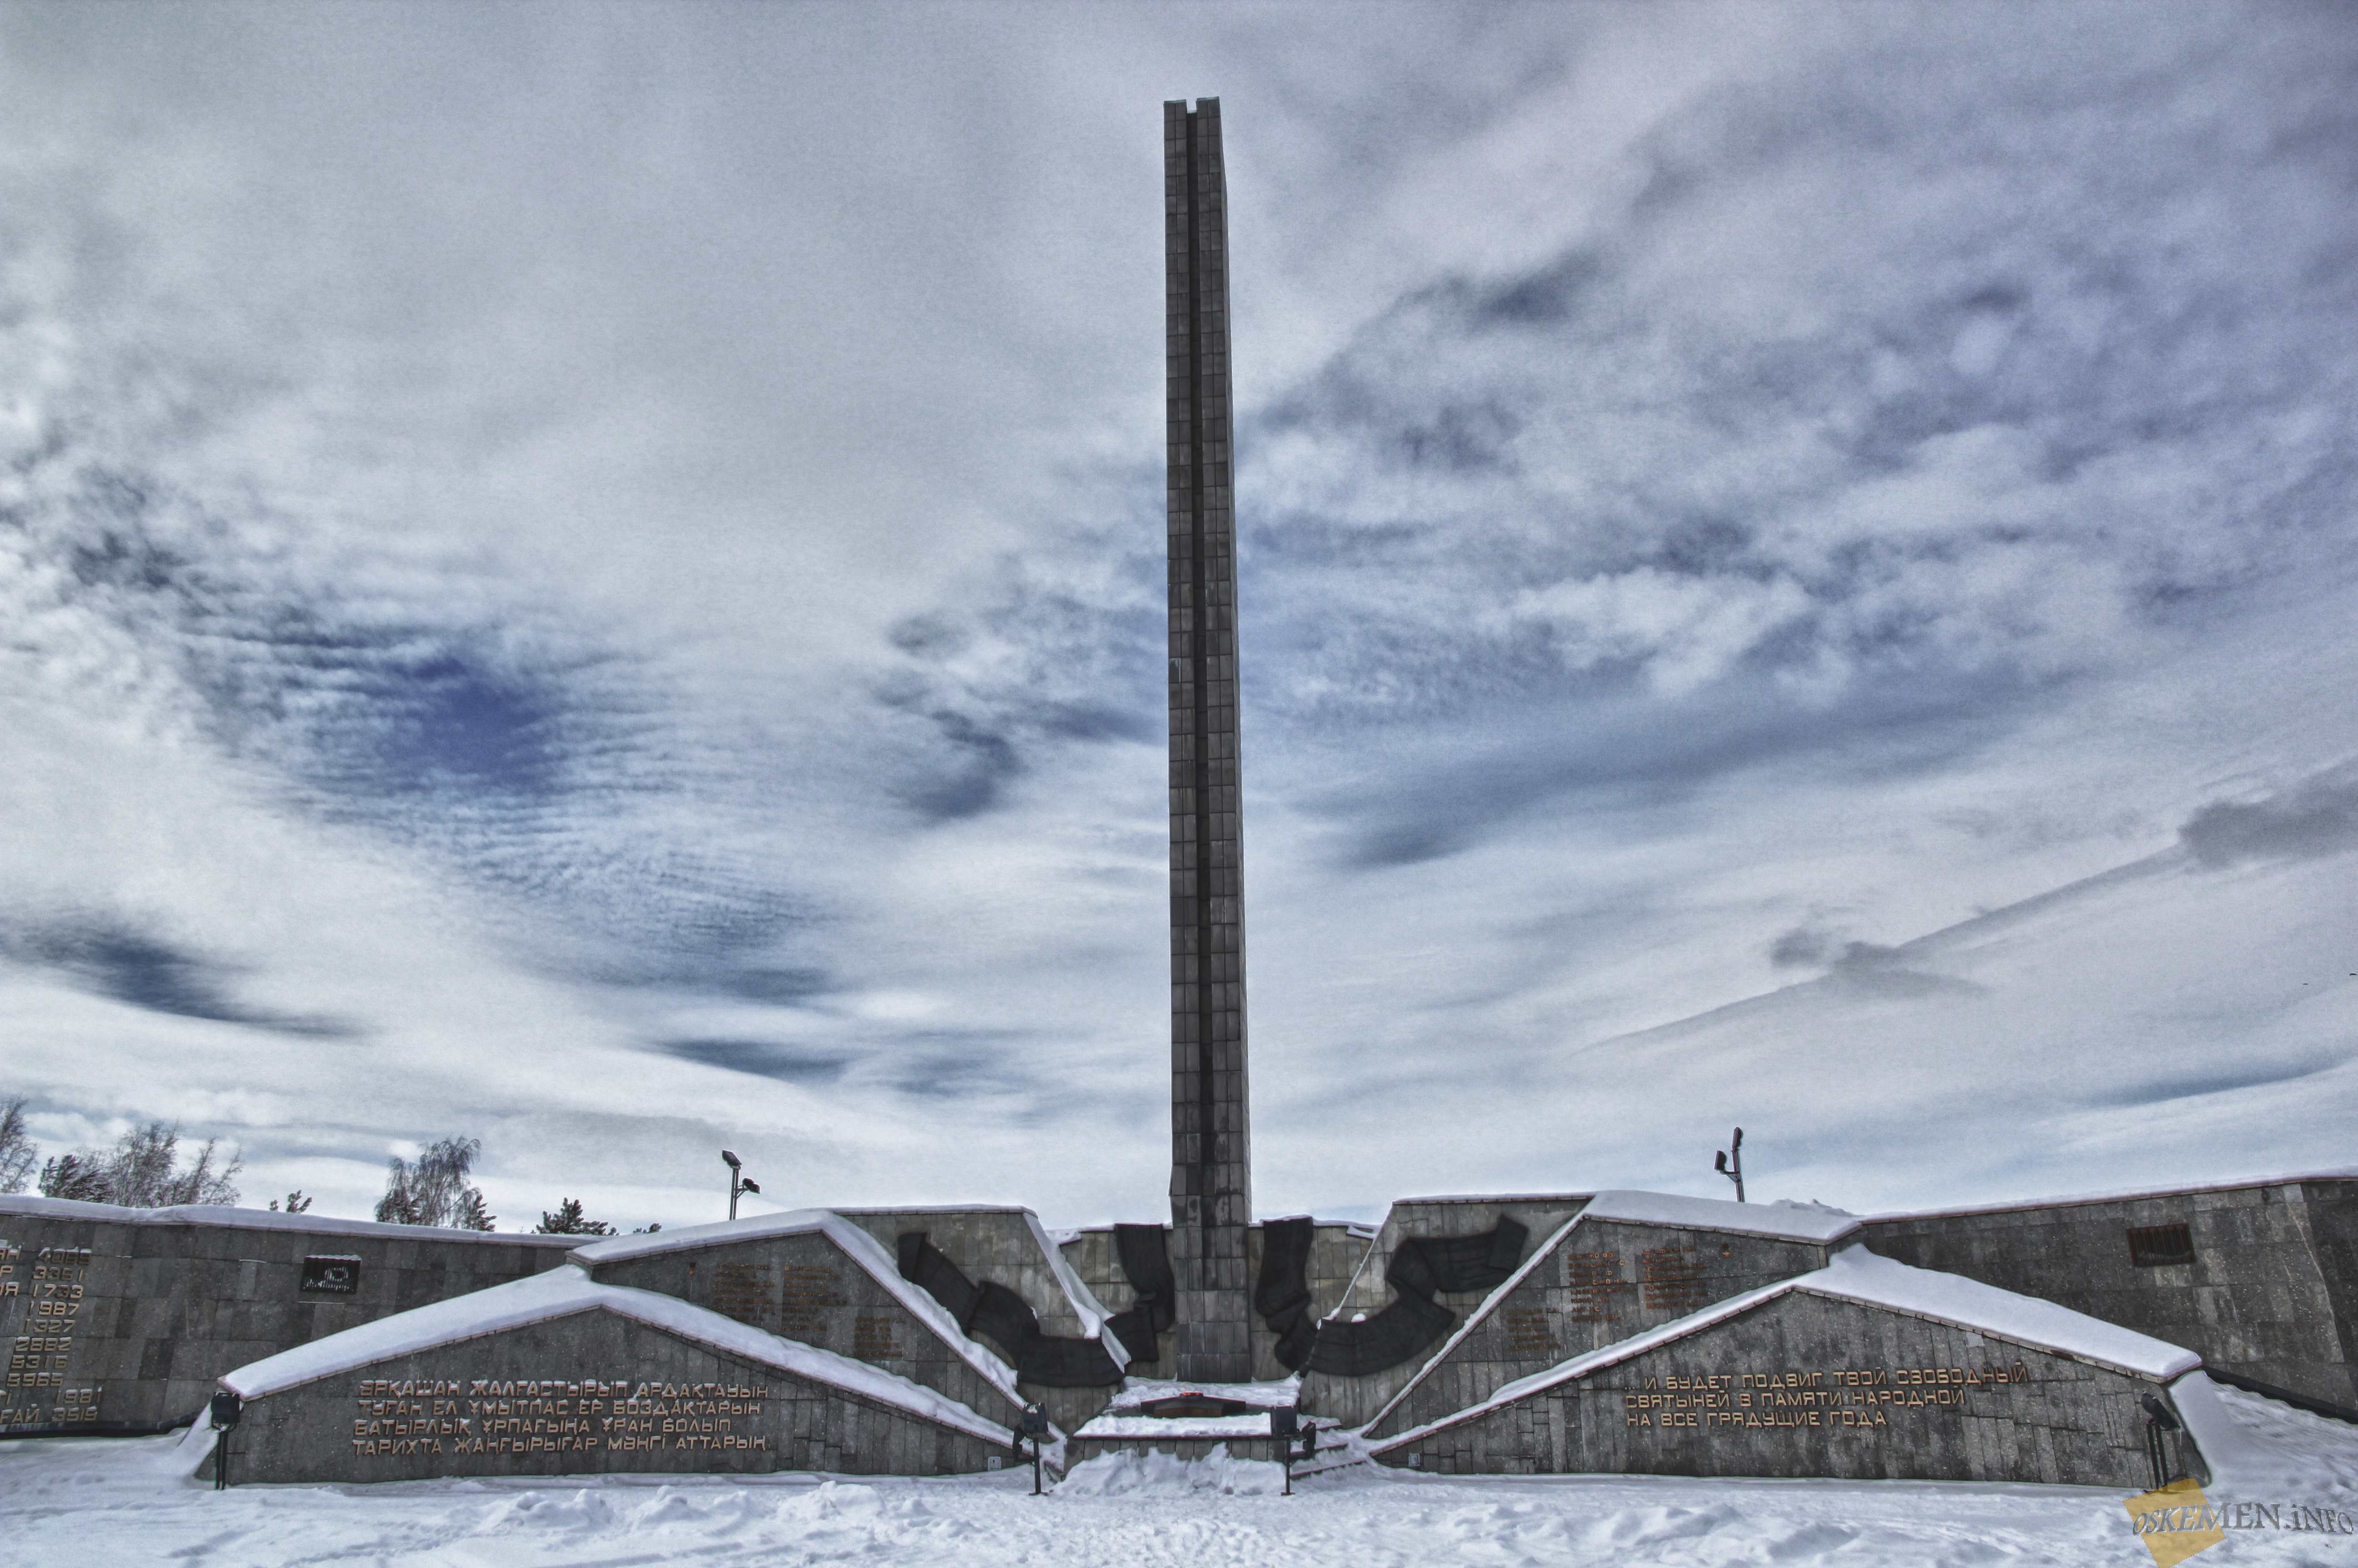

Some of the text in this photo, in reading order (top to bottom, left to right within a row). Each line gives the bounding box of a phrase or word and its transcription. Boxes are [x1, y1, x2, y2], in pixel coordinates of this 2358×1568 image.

[33, 1284, 83, 1299] 1733
[29, 1301, 79, 1316] 1987
[25, 1319, 76, 1333] 1327
[15, 1337, 72, 1351] 2882
[11, 1355, 68, 1368] 5316
[7, 1372, 63, 1387] 5965
[1645, 1377, 1658, 1390] И
[1666, 1375, 1732, 1391] БУДЕТ
[1742, 1373, 1823, 1390] ПОДВИГ
[1833, 1367, 1886, 1385] ТВОЙ
[1896, 1362, 2028, 1385] СВОБОДНЫЙ
[56, 1387, 102, 1404] 1981
[470, 1379, 628, 1397] ЖАЛҒАСТЫРЫП
[637, 1382, 768, 1398] АРДАҚТАУЫН
[1626, 1386, 1964, 1408] СВЯТЫНЕЙ В ПАМЯТИ НАРОДНОЙ
[51, 1406, 97, 1422] 3515
[358, 1398, 760, 1416] ТУҒАН ЕЛ ҰМЫТПАС ЕР БОЗДАҚТАРЫН
[354, 1417, 731, 1436] БАТЫРЛЫҚ ҰРПАҒЫҢА ҰРАН БОЛЫП
[1627, 1411, 1886, 1428] НА ВСЕ ГРЯДУЩИЕ ГОДА
[352, 1434, 766, 1456] ТАРИХТА ЖАҢҒЫРЫҒАР МӘҢГІ АТТАРЫҢ
